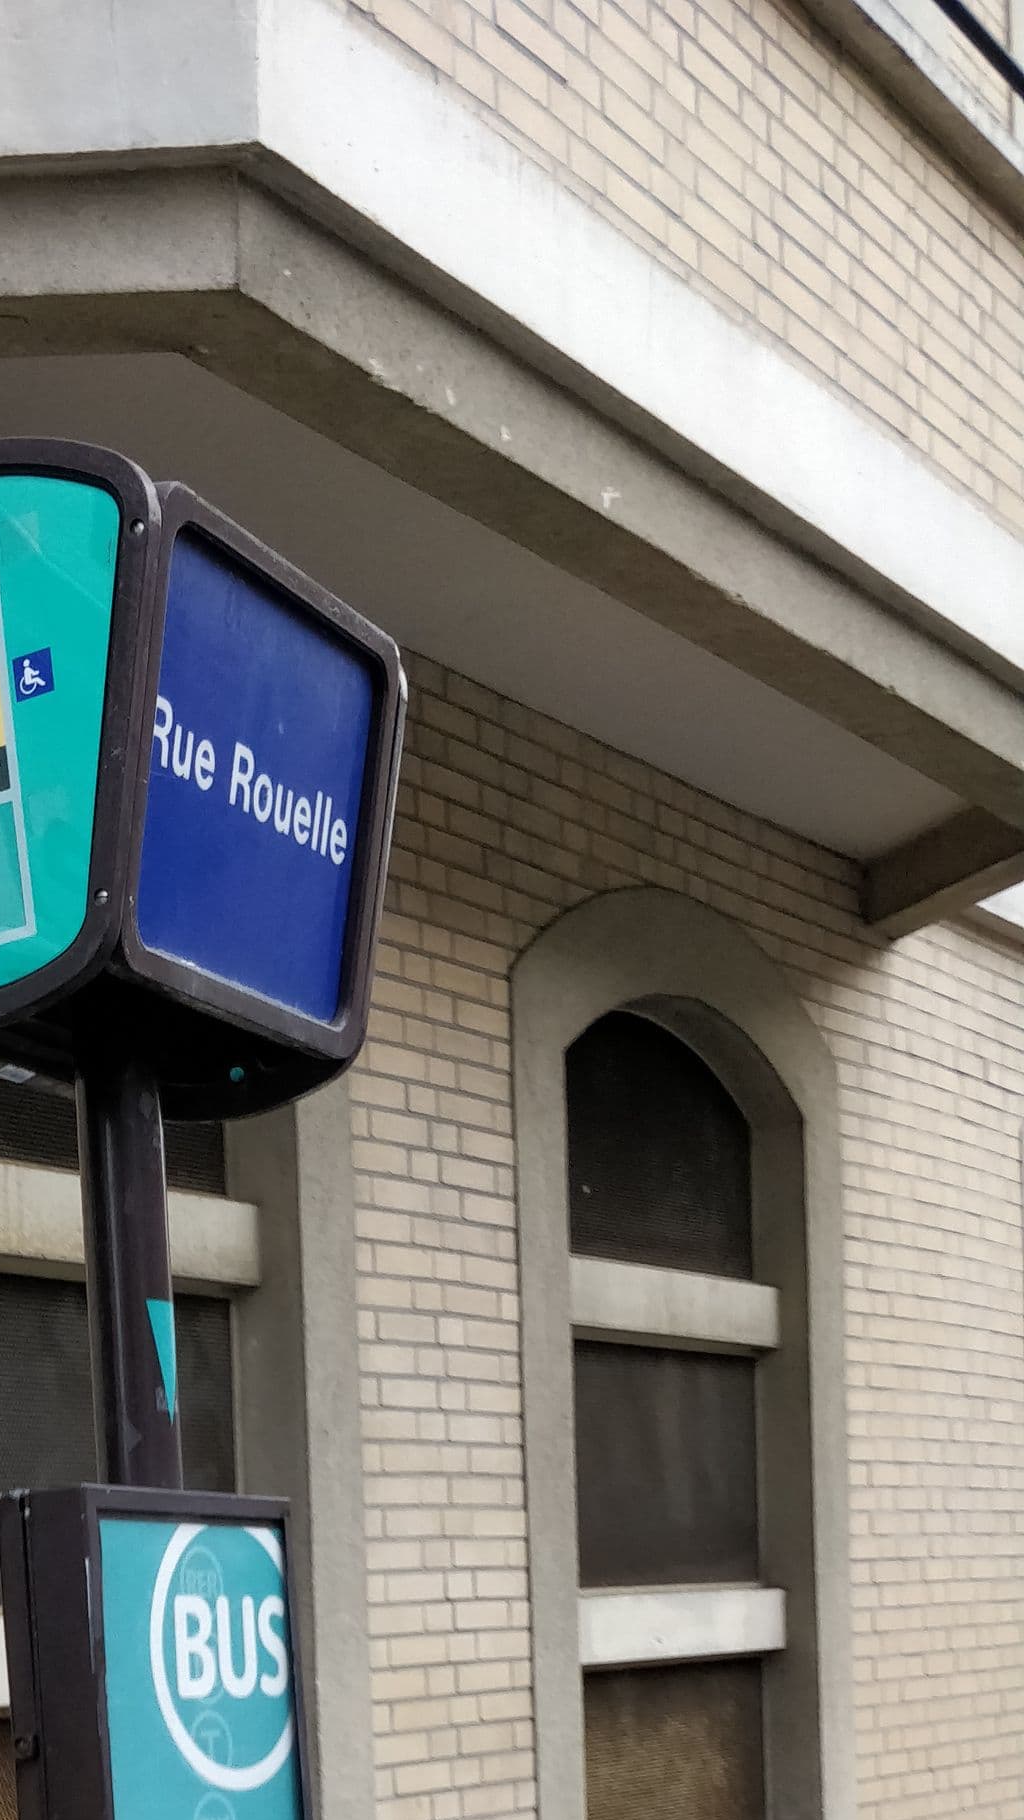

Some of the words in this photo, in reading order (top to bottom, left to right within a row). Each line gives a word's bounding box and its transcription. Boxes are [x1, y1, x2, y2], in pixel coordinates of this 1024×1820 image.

[152, 694, 216, 792] Rue
[229, 741, 348, 866] Rouelle
[174, 1594, 288, 1699] BUS
